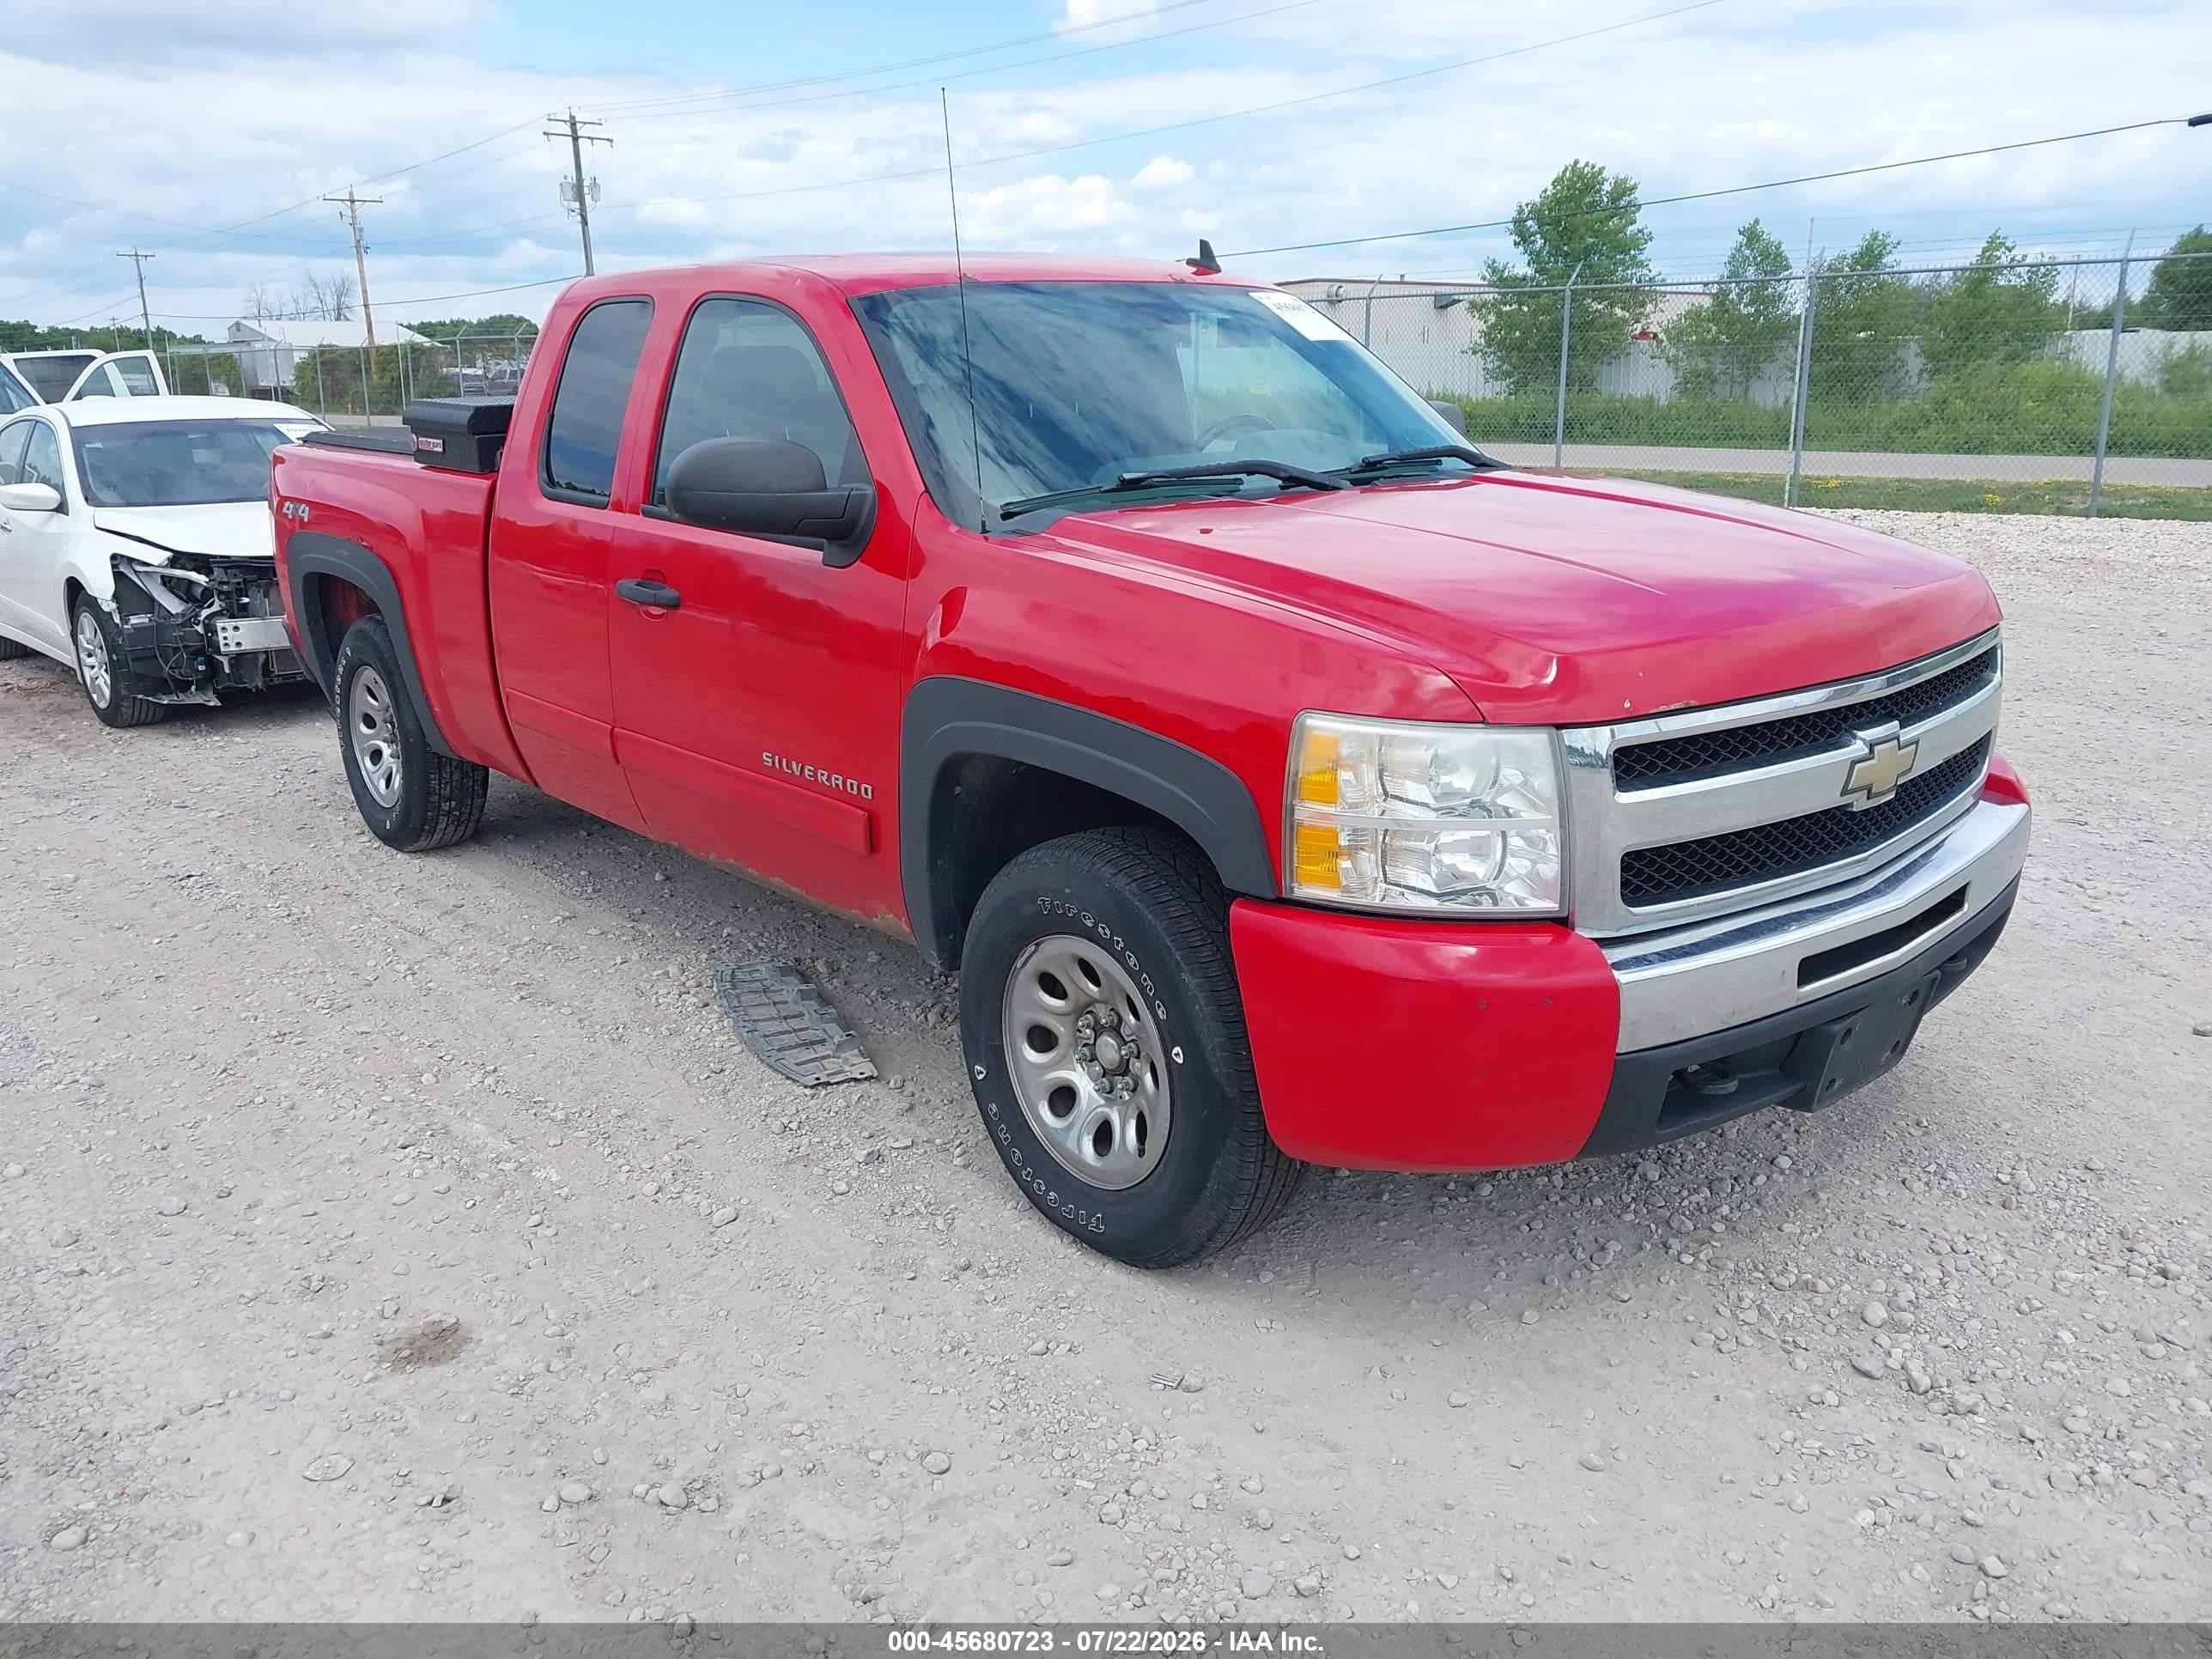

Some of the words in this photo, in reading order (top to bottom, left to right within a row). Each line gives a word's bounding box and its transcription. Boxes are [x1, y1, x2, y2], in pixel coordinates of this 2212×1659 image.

[763, 751, 873, 799] SILVERADO
[1037, 896, 1167, 1021] Firestone
[988, 1102, 1105, 1232] Firestone
